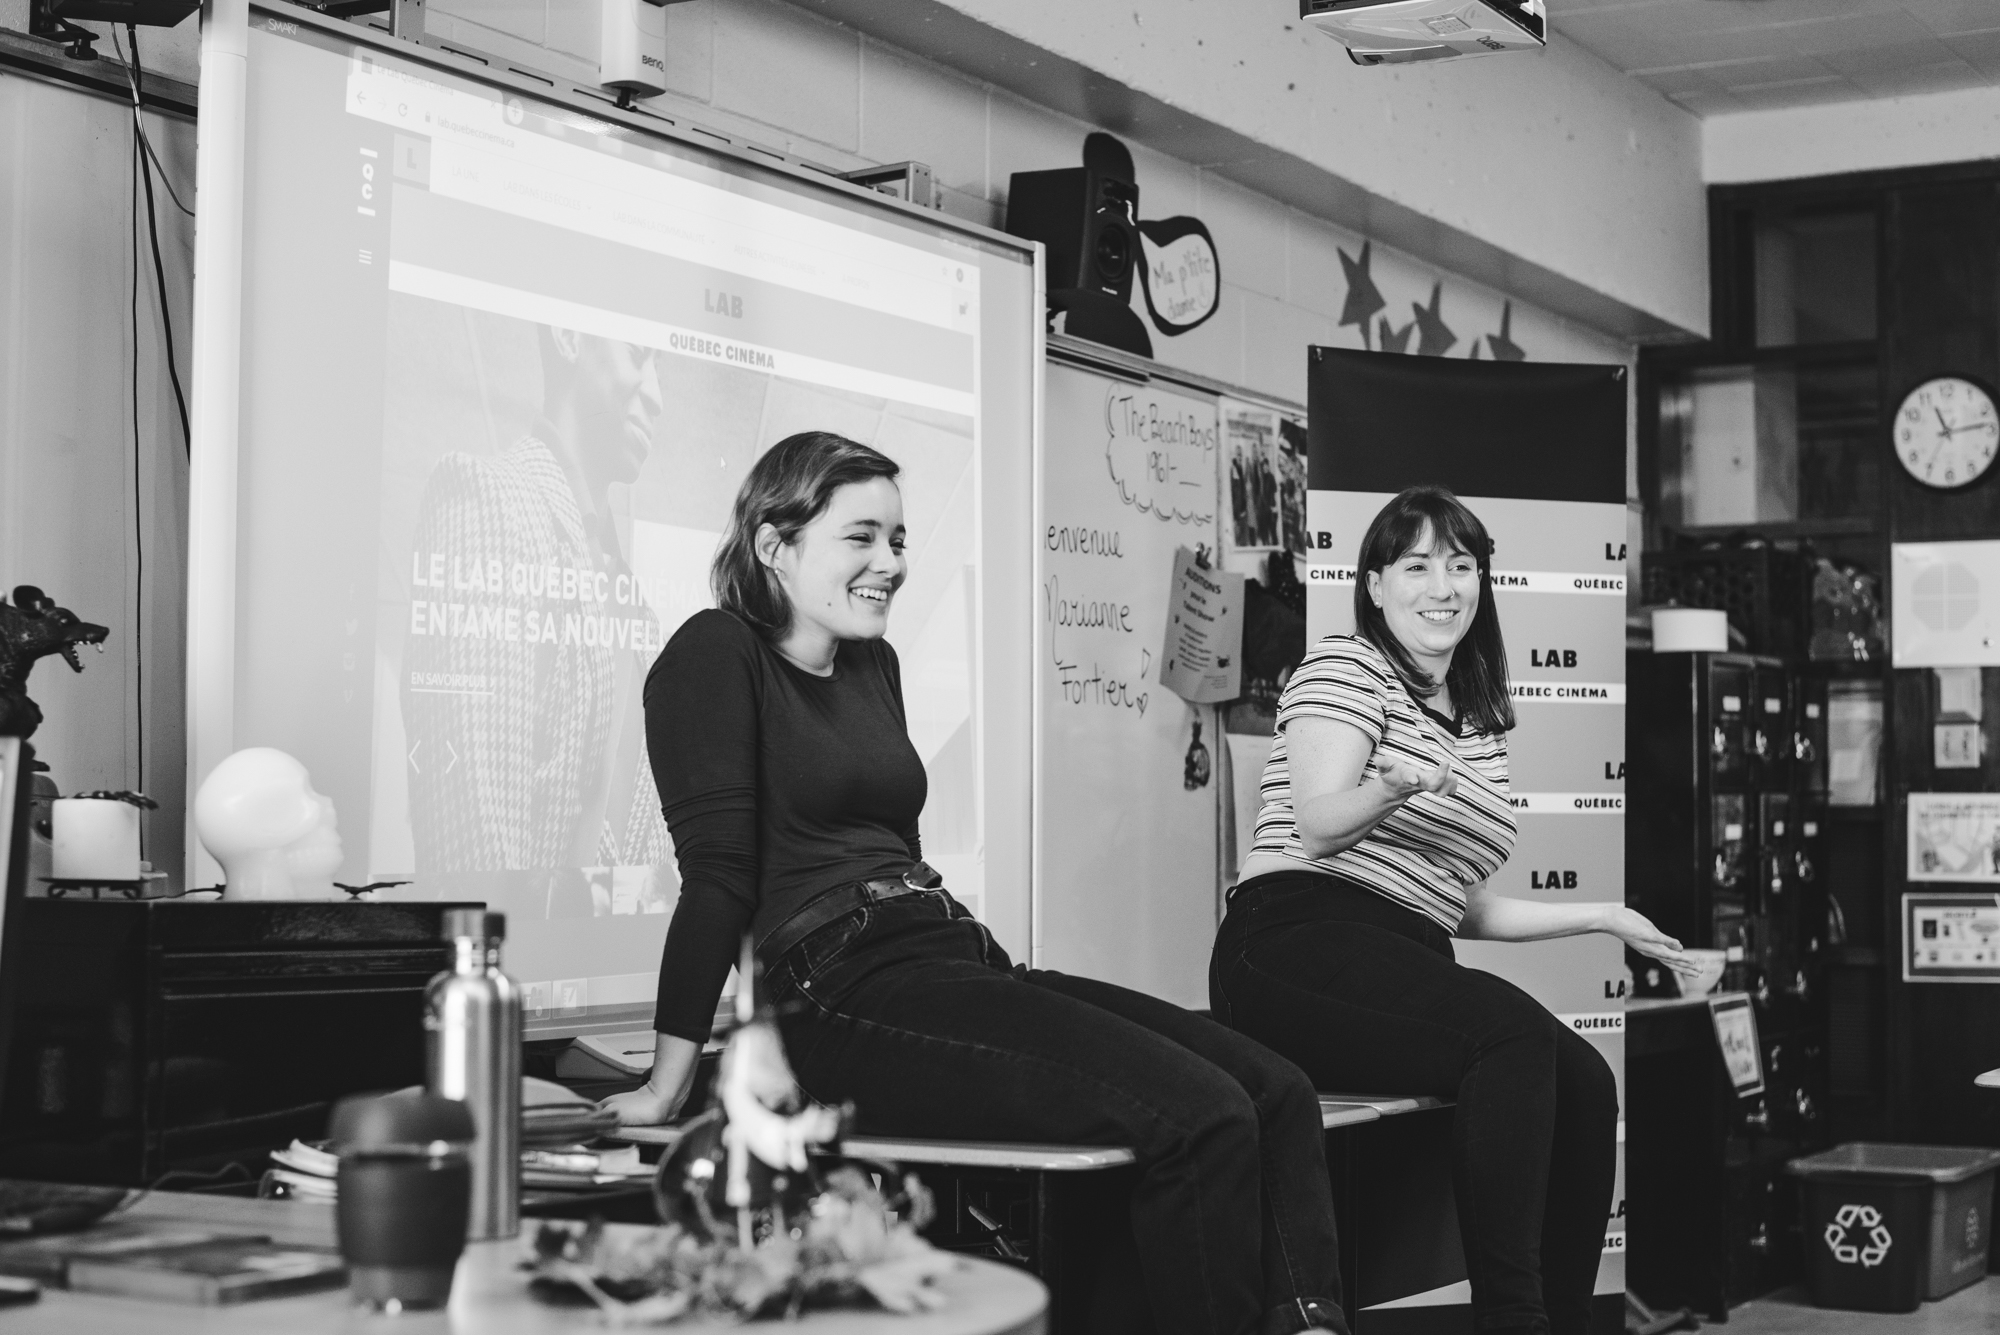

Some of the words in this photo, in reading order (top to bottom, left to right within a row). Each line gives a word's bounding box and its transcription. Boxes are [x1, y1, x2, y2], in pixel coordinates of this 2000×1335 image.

[269, 18, 299, 36] SMART
[642, 55, 664, 72] BenQ
[437, 115, 516, 149] lab.quebeccinema.ca
[704, 288, 744, 319] LAB
[669, 332, 722, 358] QUÉBEC
[725, 345, 776, 369] CINÉMA
[1119, 395, 1148, 443] The
[1149, 403, 1189, 446] Beach
[1189, 414, 1214, 464] Boys
[412, 551, 446, 587] LE
[453, 555, 504, 593] LAB
[511, 556, 609, 602] QUÉBEC
[1574, 578, 1623, 589] QUÉBEC
[411, 600, 519, 642] ENTAME
[526, 610, 559, 645] SA
[1531, 649, 1578, 668] LAB
[411, 671, 424, 686] EN
[425, 672, 461, 687] SAVOIR
[462, 674, 487, 688] PLUS
[1058, 662, 1134, 708] Fortier
[1557, 687, 1608, 698] CINÉMA
[1574, 798, 1622, 809] QUÉBEC
[1531, 870, 1578, 889] LAB
[1574, 1017, 1623, 1029] QUÉBEC
